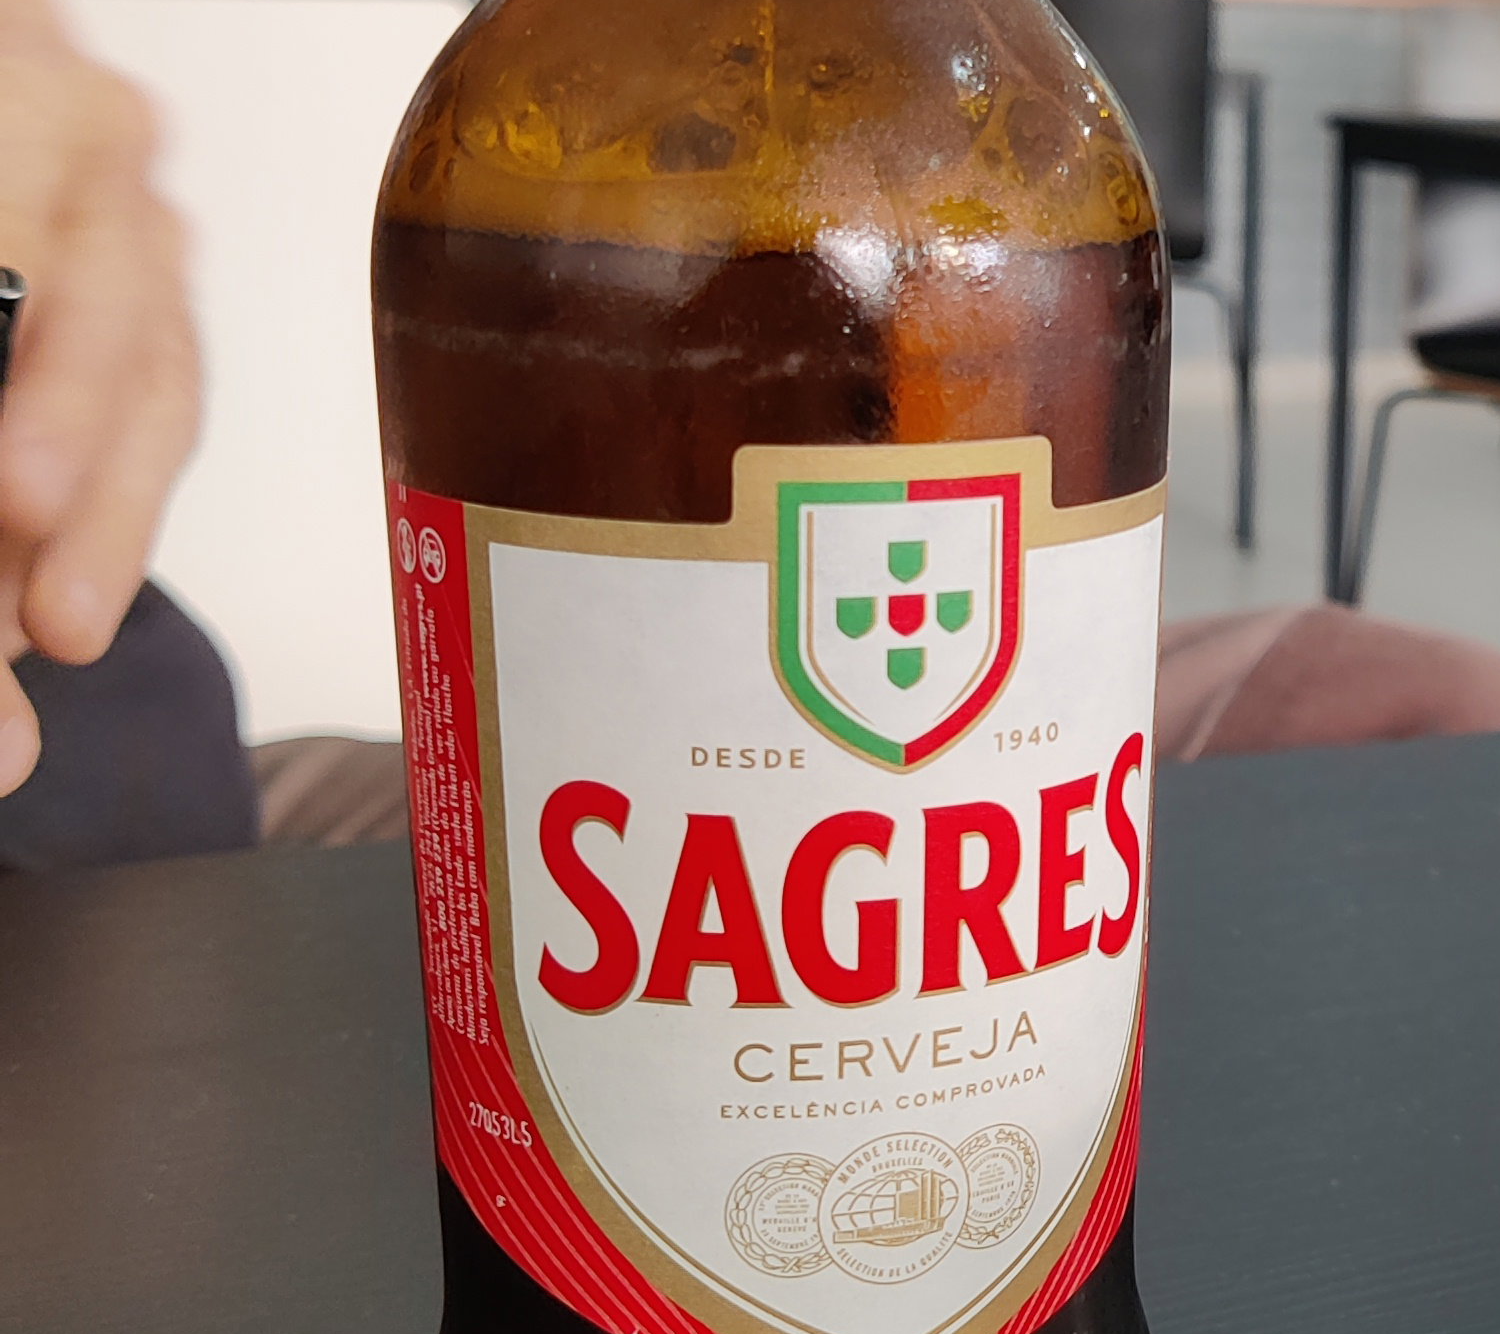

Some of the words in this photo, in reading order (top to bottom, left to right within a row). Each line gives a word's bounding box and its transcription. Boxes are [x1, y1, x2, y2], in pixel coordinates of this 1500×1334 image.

[993, 721, 1060, 753] 1940
[691, 746, 806, 769] DESDE
[469, 861, 477, 888] com
[538, 733, 1145, 1014] SAGRES
[469, 892, 480, 927] Beba
[479, 1017, 490, 1047] Seja
[733, 1010, 1038, 1083] CERVEJA
[720, 1099, 884, 1120] EXCELÊNCIA
[896, 1064, 1047, 1109] COMPROVADA
[838, 1145, 881, 1185] MONDE
